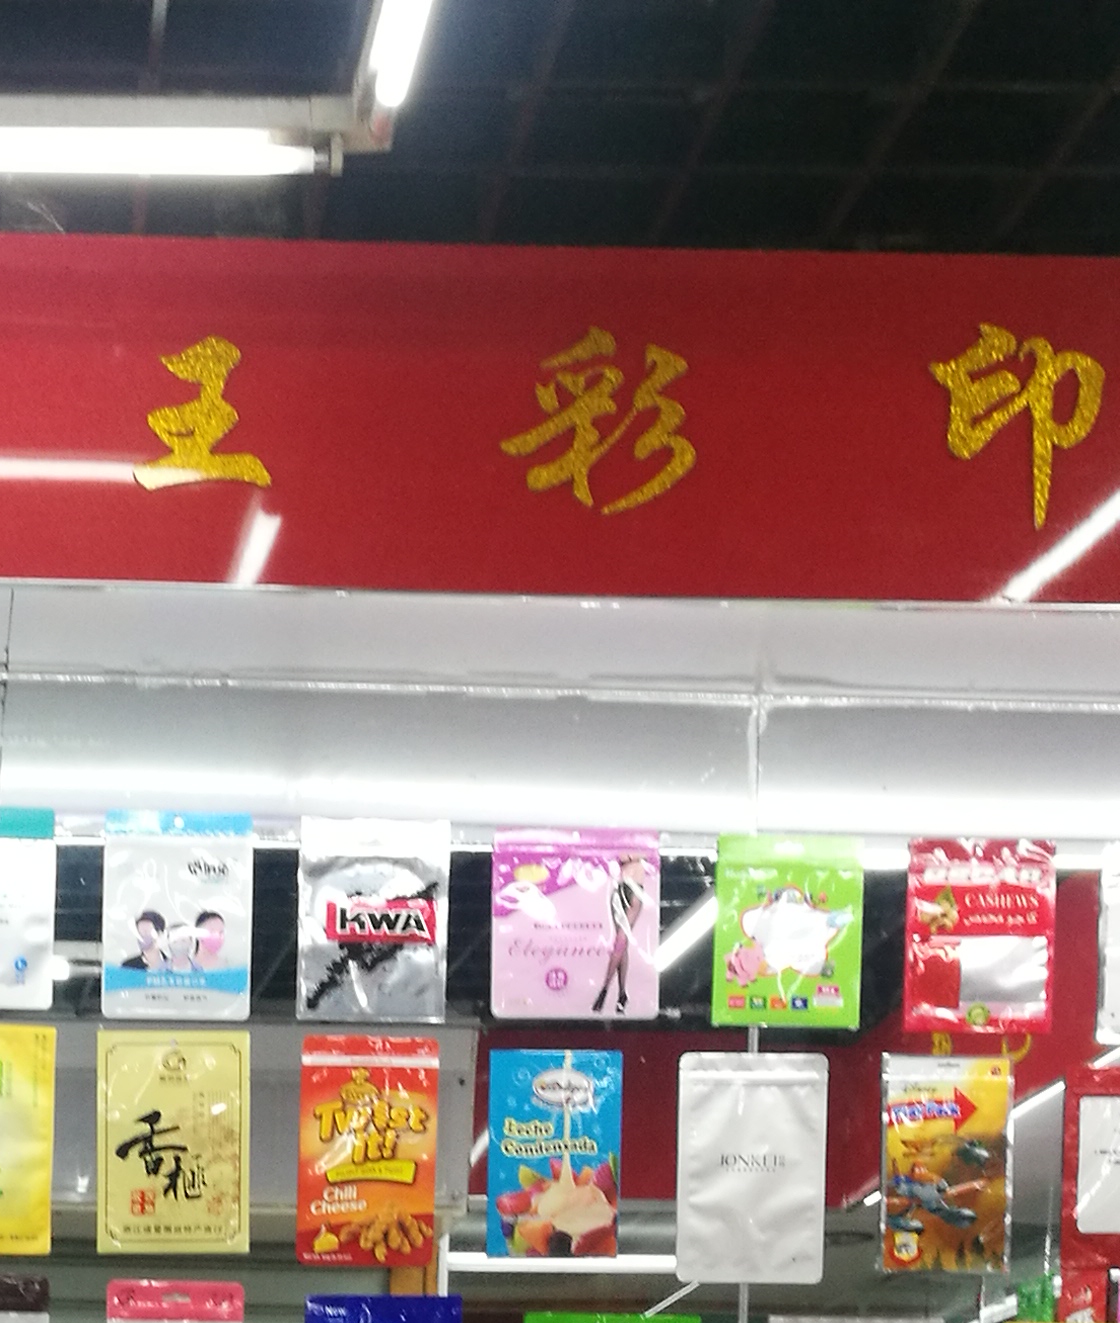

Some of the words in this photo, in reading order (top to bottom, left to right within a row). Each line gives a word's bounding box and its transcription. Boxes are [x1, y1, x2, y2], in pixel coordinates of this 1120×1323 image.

[965, 893, 1040, 909] CASHEWS
[339, 906, 429, 934] KWA
[313, 1099, 429, 1142] Twist
[504, 1117, 553, 1137] Leche
[502, 1137, 597, 1157] Condensada
[323, 1186, 357, 1202] Chili
[310, 1199, 367, 1216] Cheese
